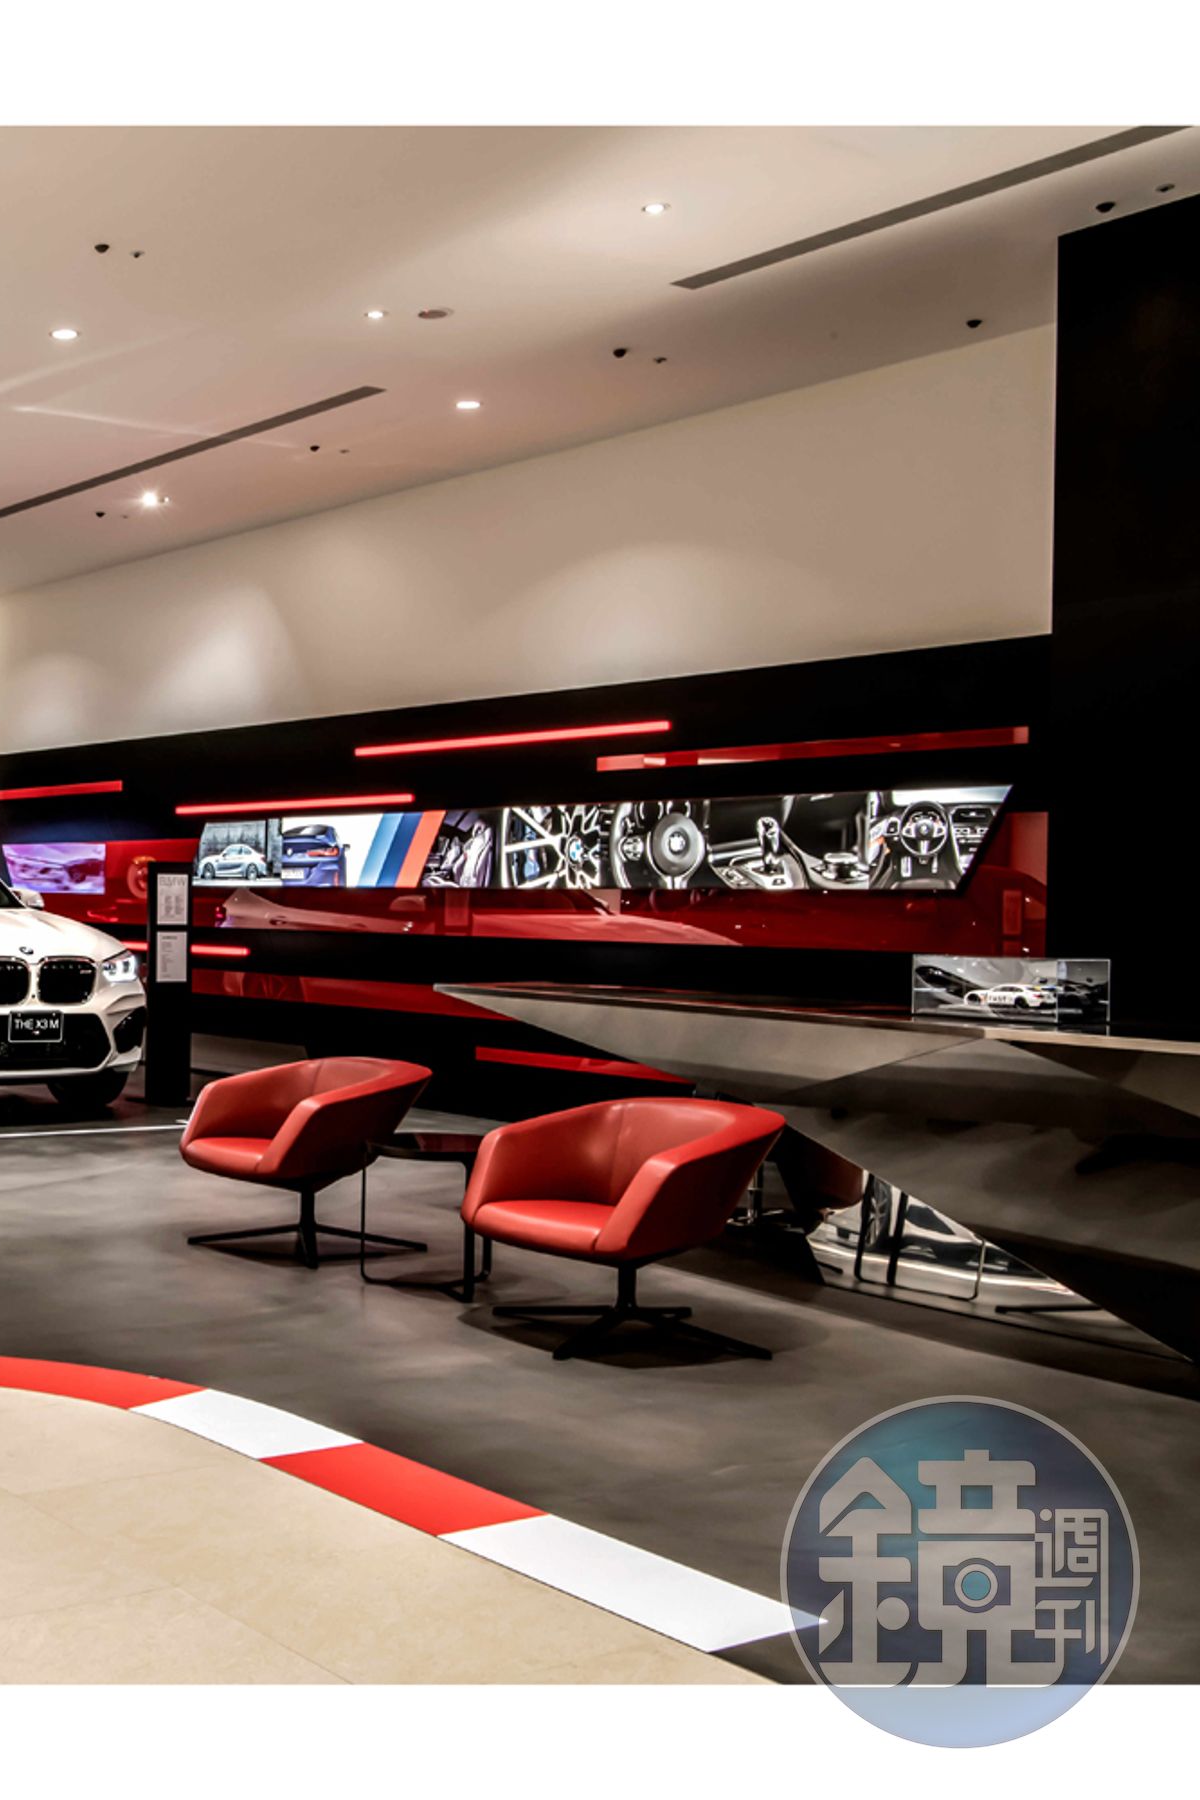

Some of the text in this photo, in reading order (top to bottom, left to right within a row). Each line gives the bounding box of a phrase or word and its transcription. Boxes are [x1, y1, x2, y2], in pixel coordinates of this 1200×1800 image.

[14, 1018, 60, 1030] THE X3 M
